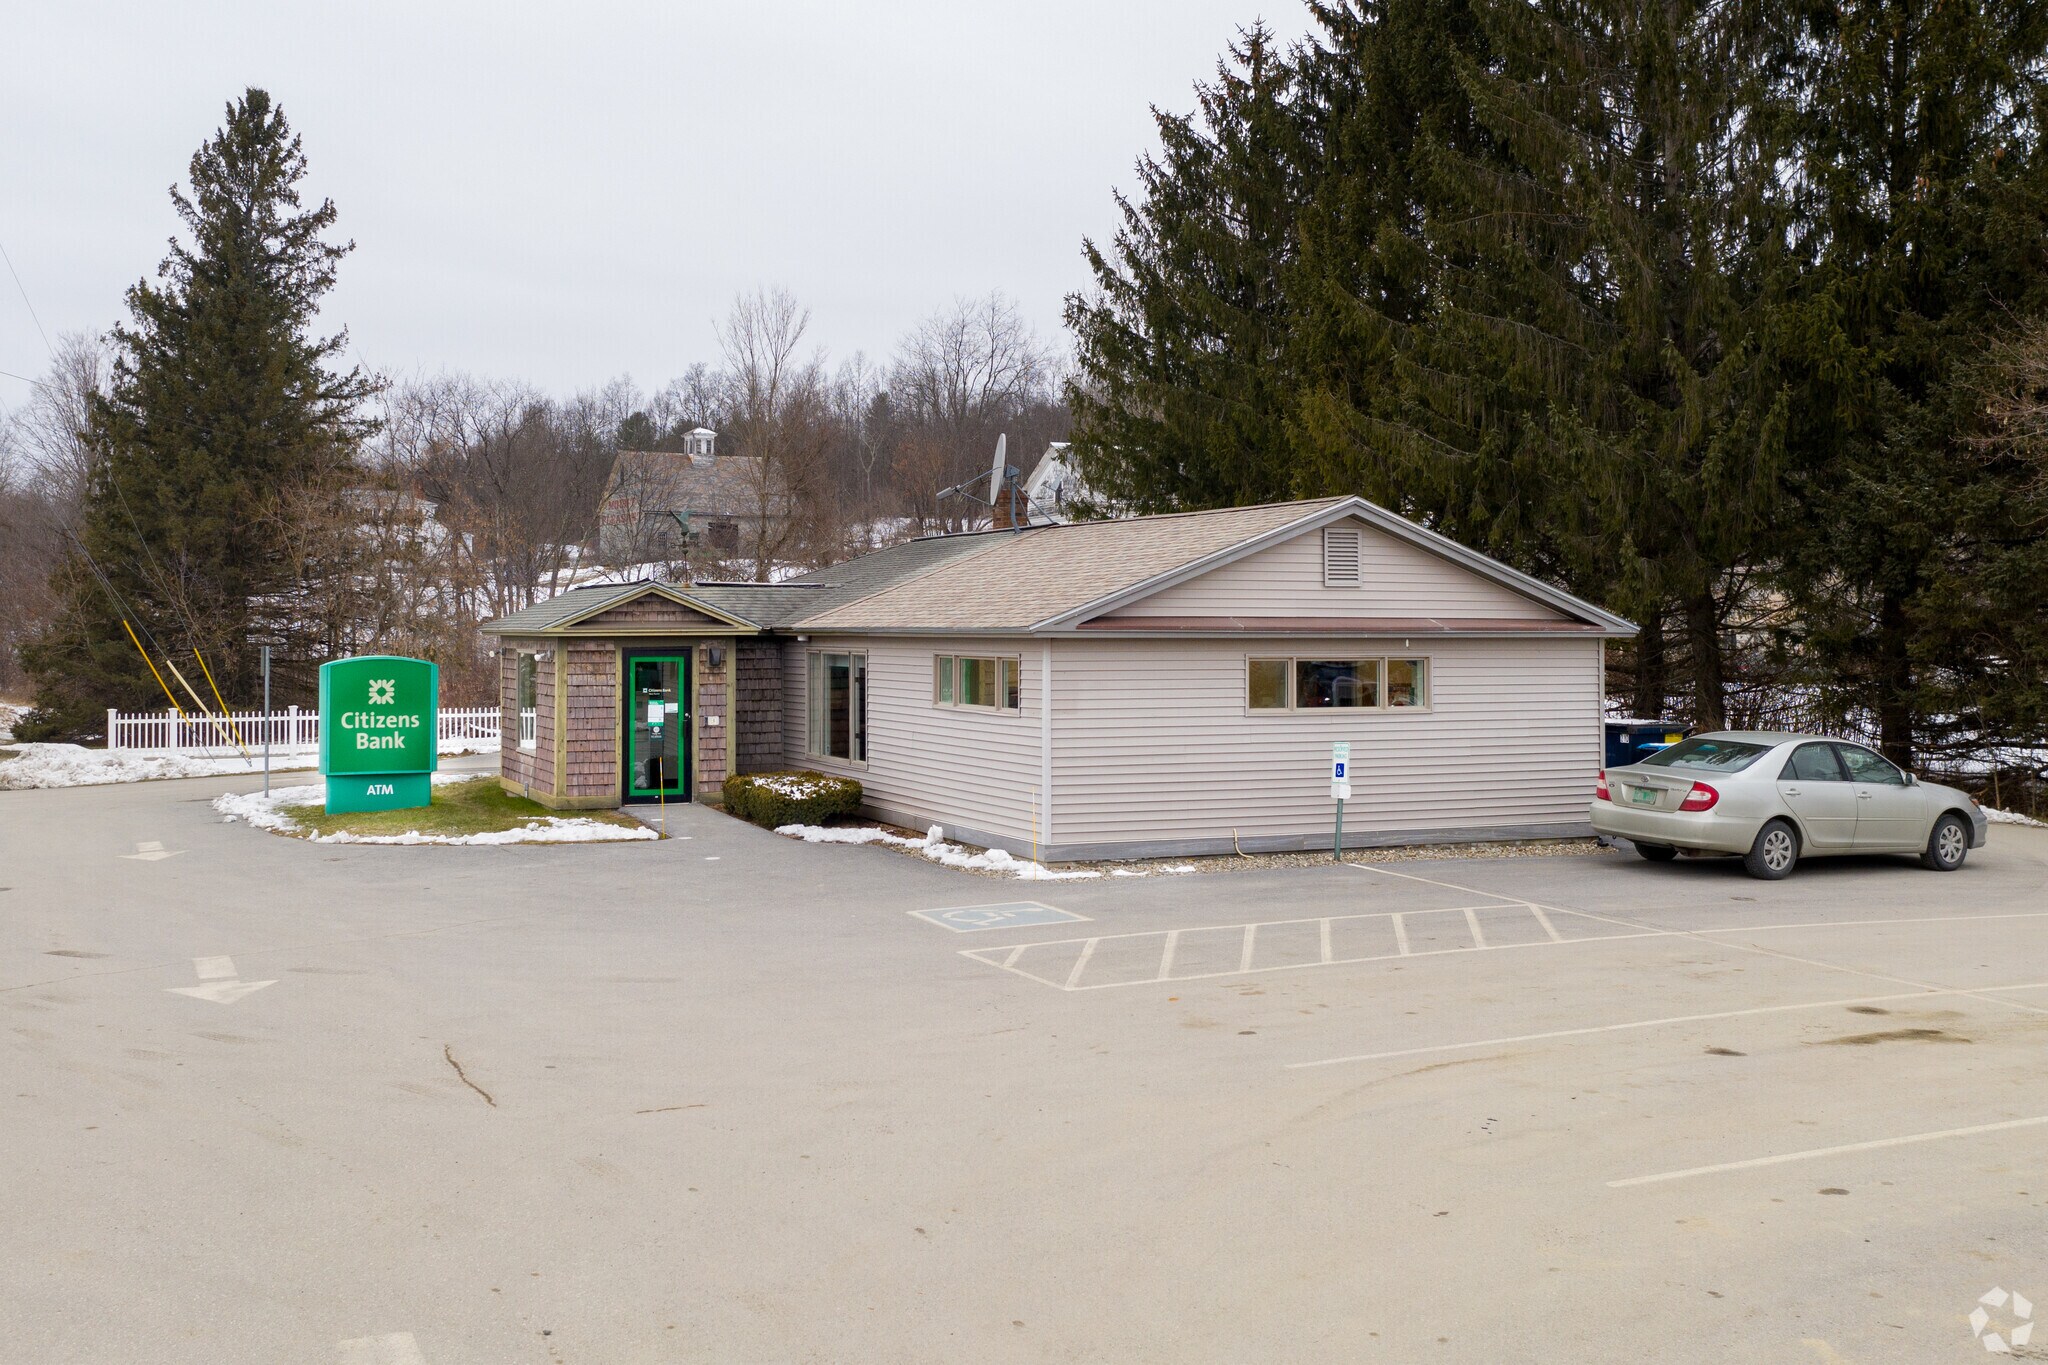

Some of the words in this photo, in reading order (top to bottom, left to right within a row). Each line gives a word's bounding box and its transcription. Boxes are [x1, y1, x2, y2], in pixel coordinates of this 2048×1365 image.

[341, 711, 420, 729] Citizens
[356, 731, 406, 750] Bank
[366, 784, 394, 796] ATM
